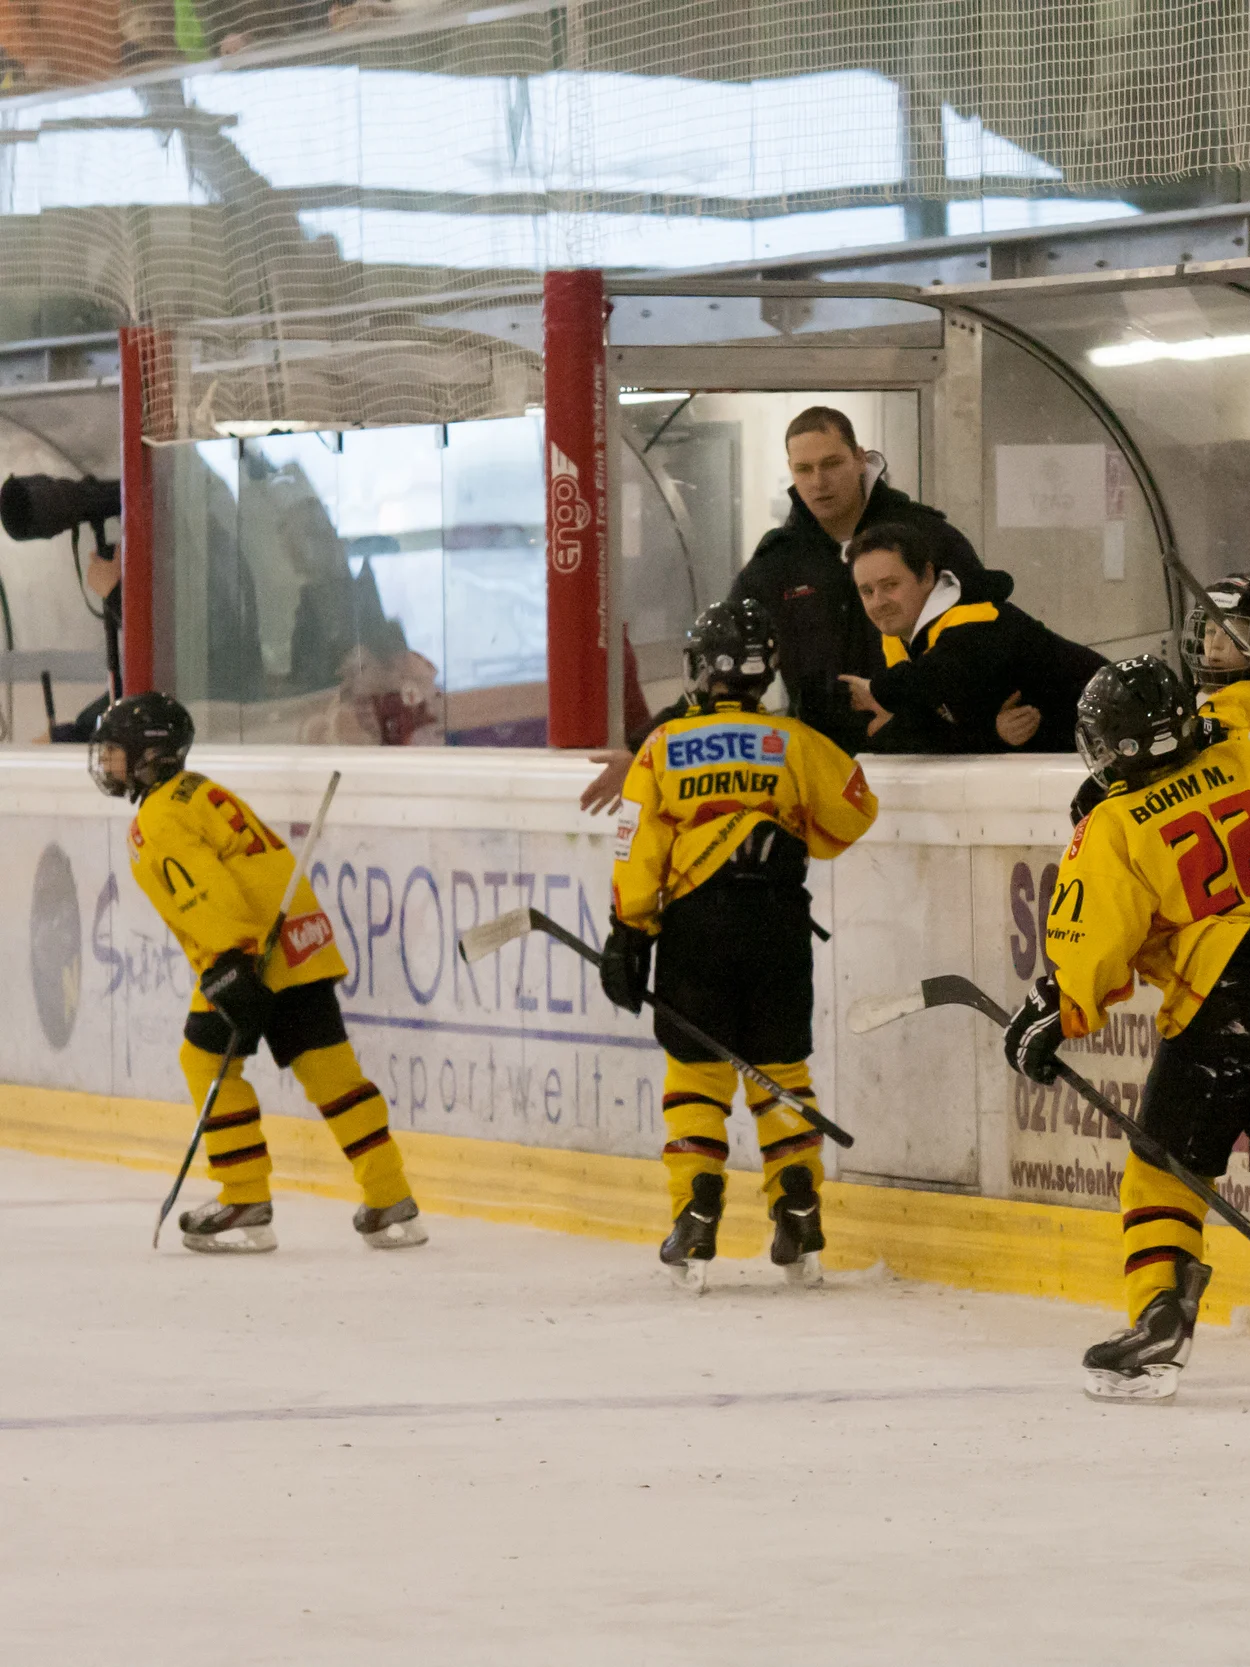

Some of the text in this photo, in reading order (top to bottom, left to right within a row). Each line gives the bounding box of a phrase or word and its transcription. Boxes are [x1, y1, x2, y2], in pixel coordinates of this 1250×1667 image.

[667, 731, 757, 768] ERSTE
[1130, 780, 1201, 825] BÖHM
[1201, 765, 1235, 788] M.
[1011, 1159, 1124, 1198] www.schenk
